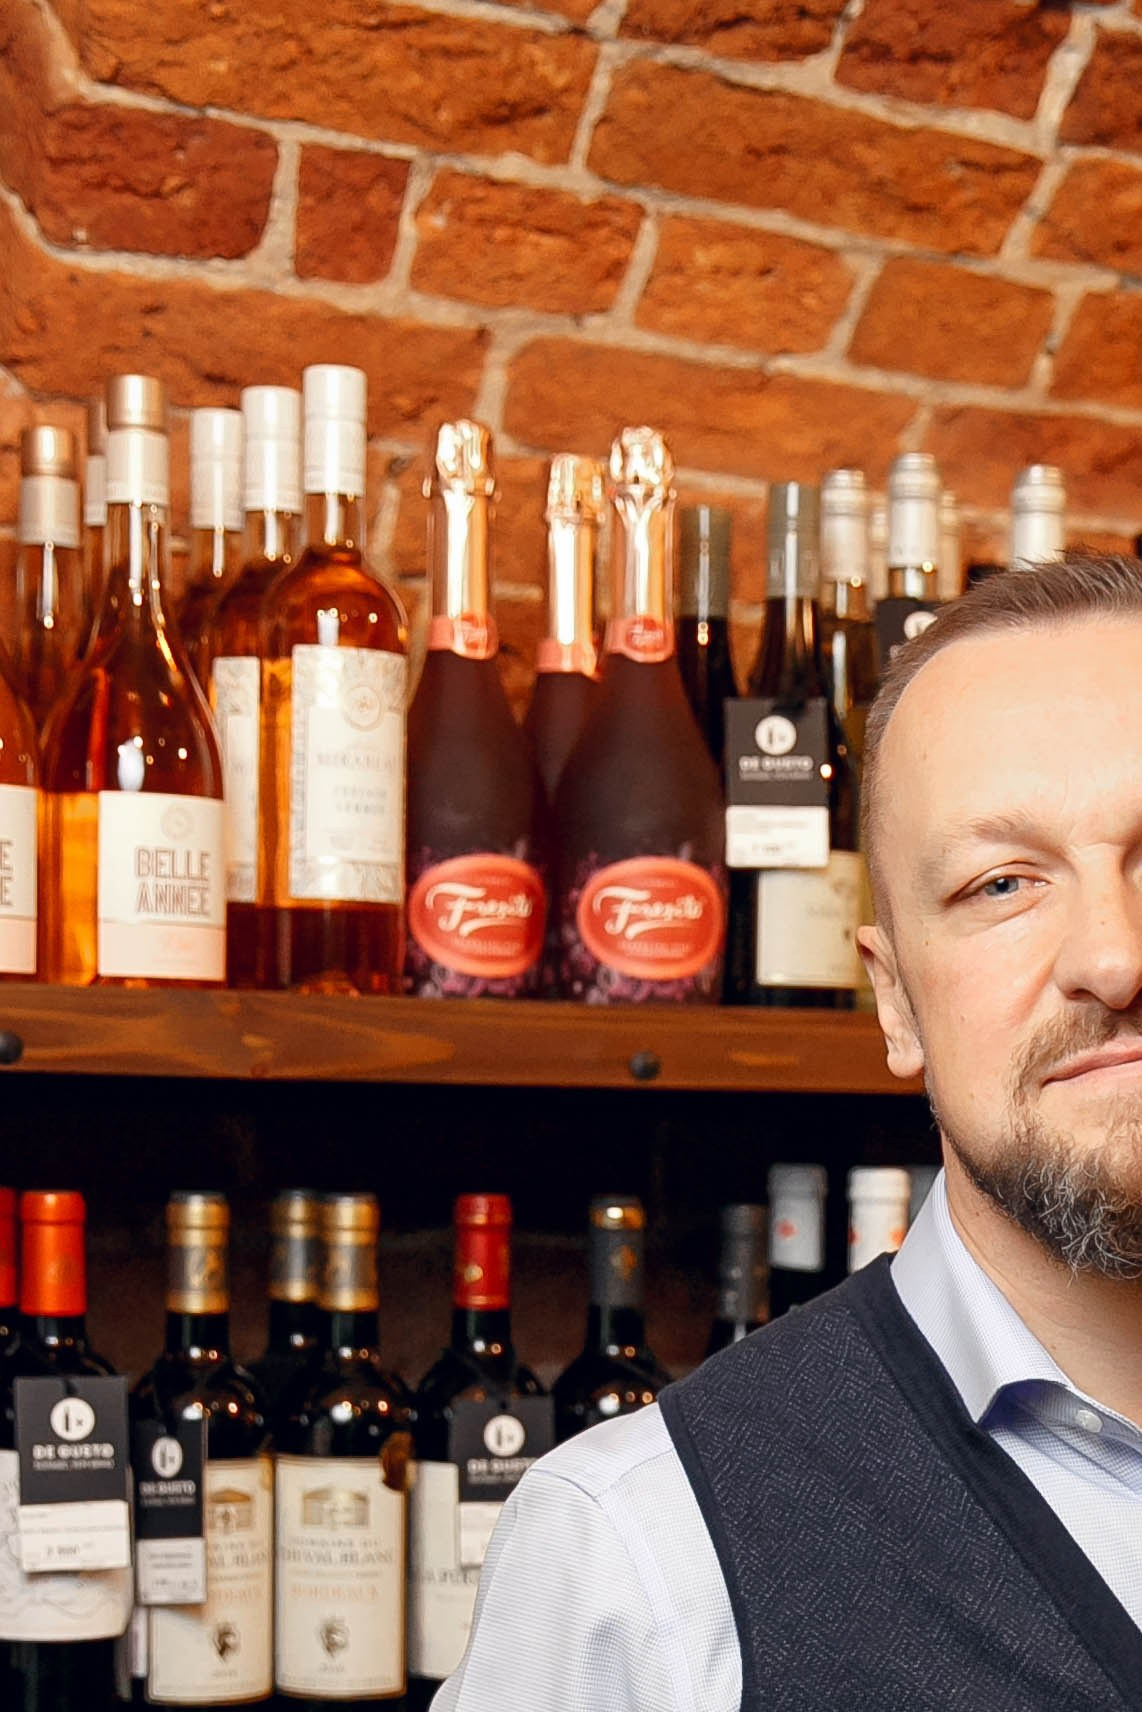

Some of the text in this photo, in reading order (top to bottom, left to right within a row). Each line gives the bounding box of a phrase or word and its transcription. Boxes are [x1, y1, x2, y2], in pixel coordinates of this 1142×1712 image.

[136, 847, 210, 881] BELLE
[33, 1443, 114, 1460] DE GUSTO
